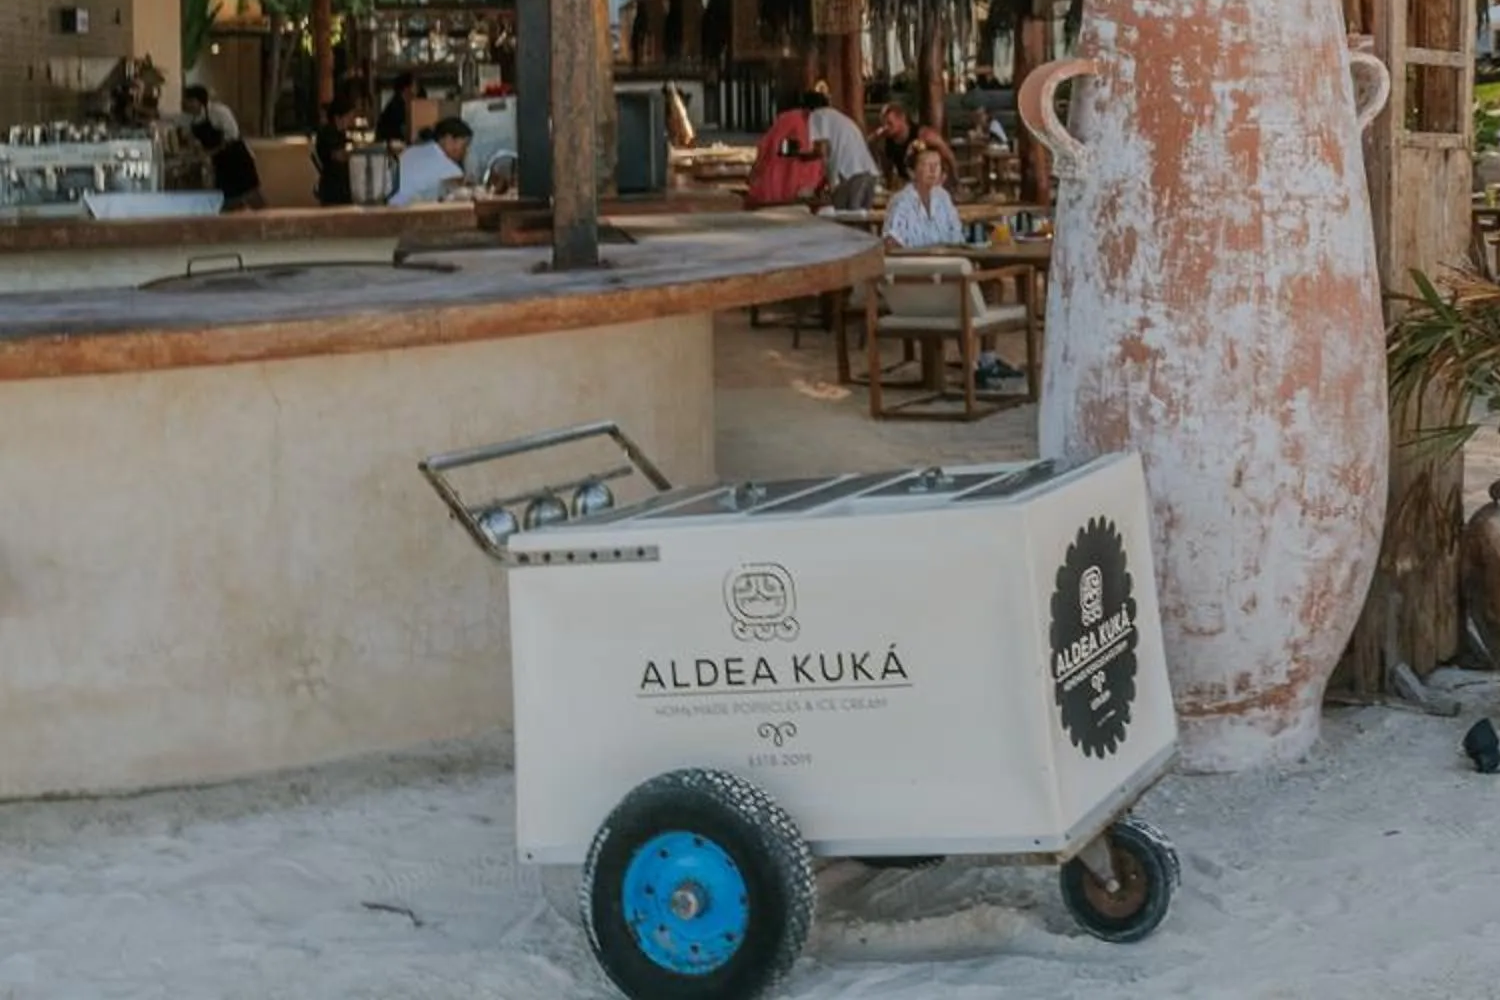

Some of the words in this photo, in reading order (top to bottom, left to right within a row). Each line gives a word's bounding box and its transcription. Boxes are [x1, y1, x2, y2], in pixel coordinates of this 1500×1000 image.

[640, 656, 778, 690] ALDEA
[792, 643, 909, 684] KUKÁ
[1056, 631, 1100, 678] ALDEA
[1098, 602, 1131, 647] KUKÁ
